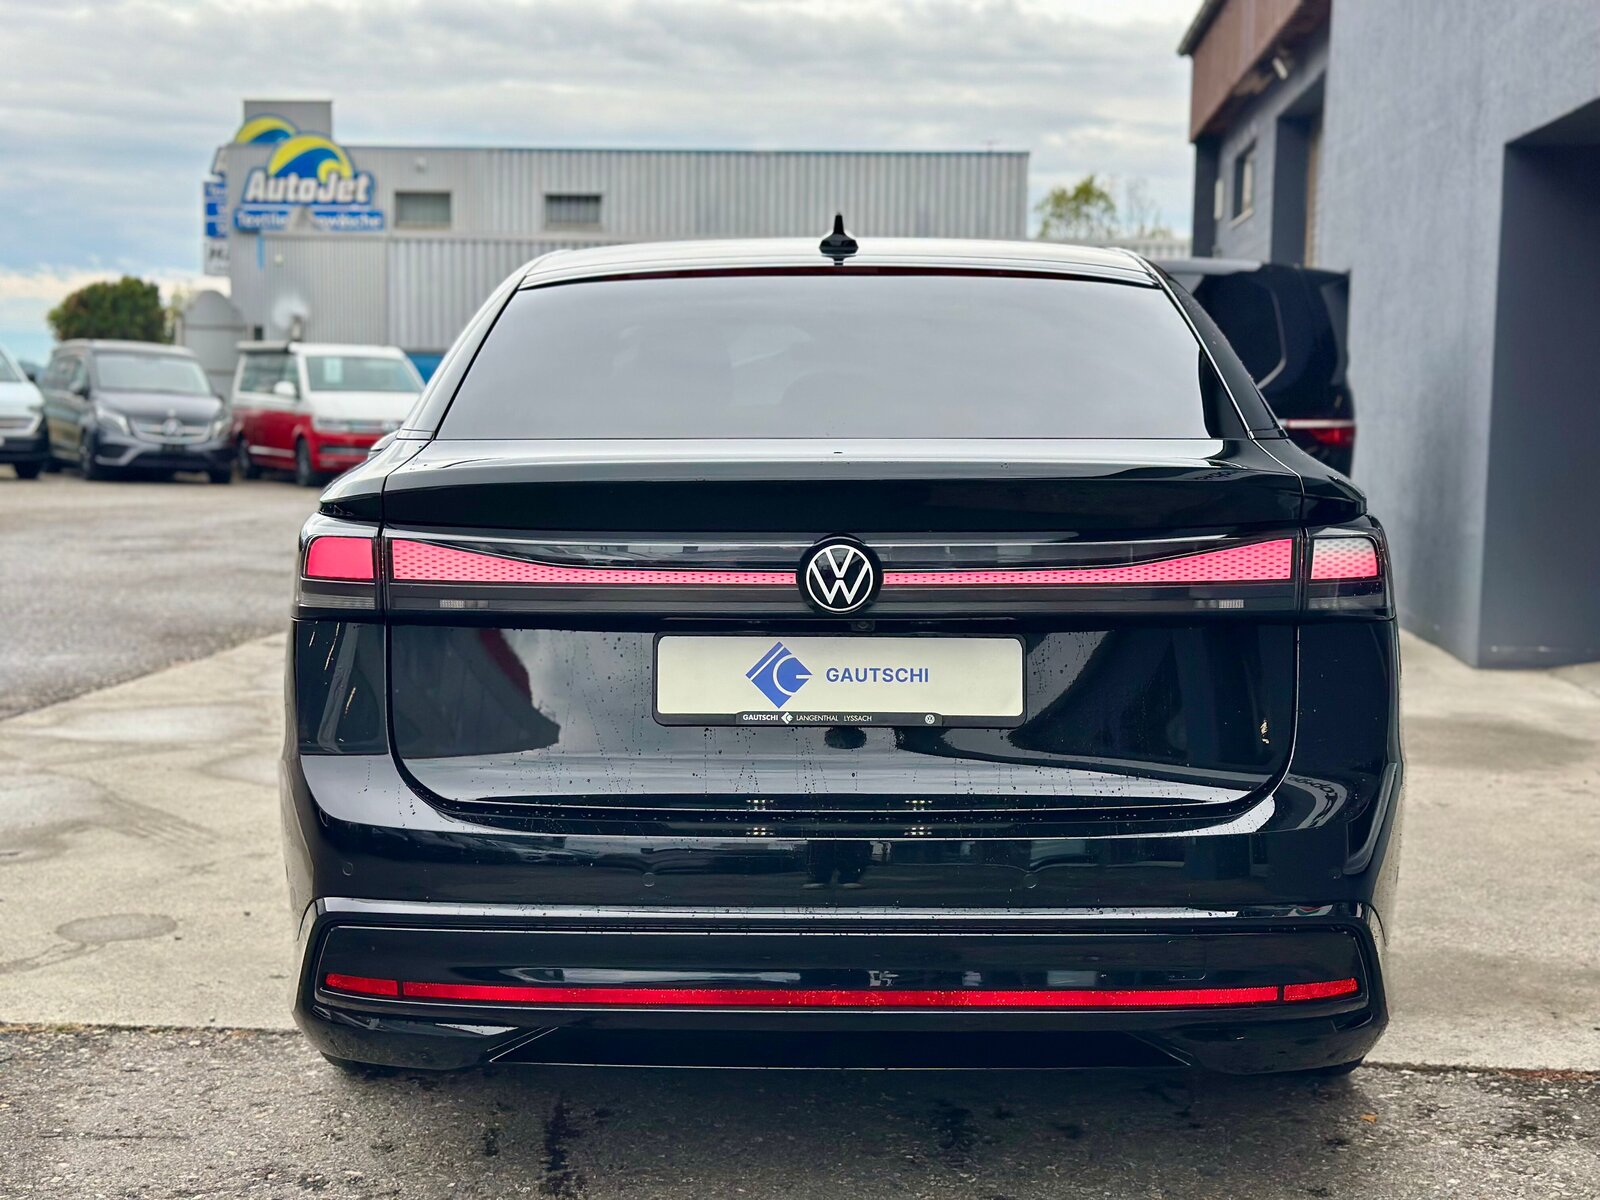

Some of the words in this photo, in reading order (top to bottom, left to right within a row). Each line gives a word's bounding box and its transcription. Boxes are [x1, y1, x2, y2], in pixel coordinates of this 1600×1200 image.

[244, 169, 371, 204] AutoJet
[825, 667, 930, 684] GAUTSCHI
[742, 713, 779, 721] GAUTSCHI
[796, 714, 839, 722] LANGENTHAL
[843, 714, 873, 722] LYSSACH
